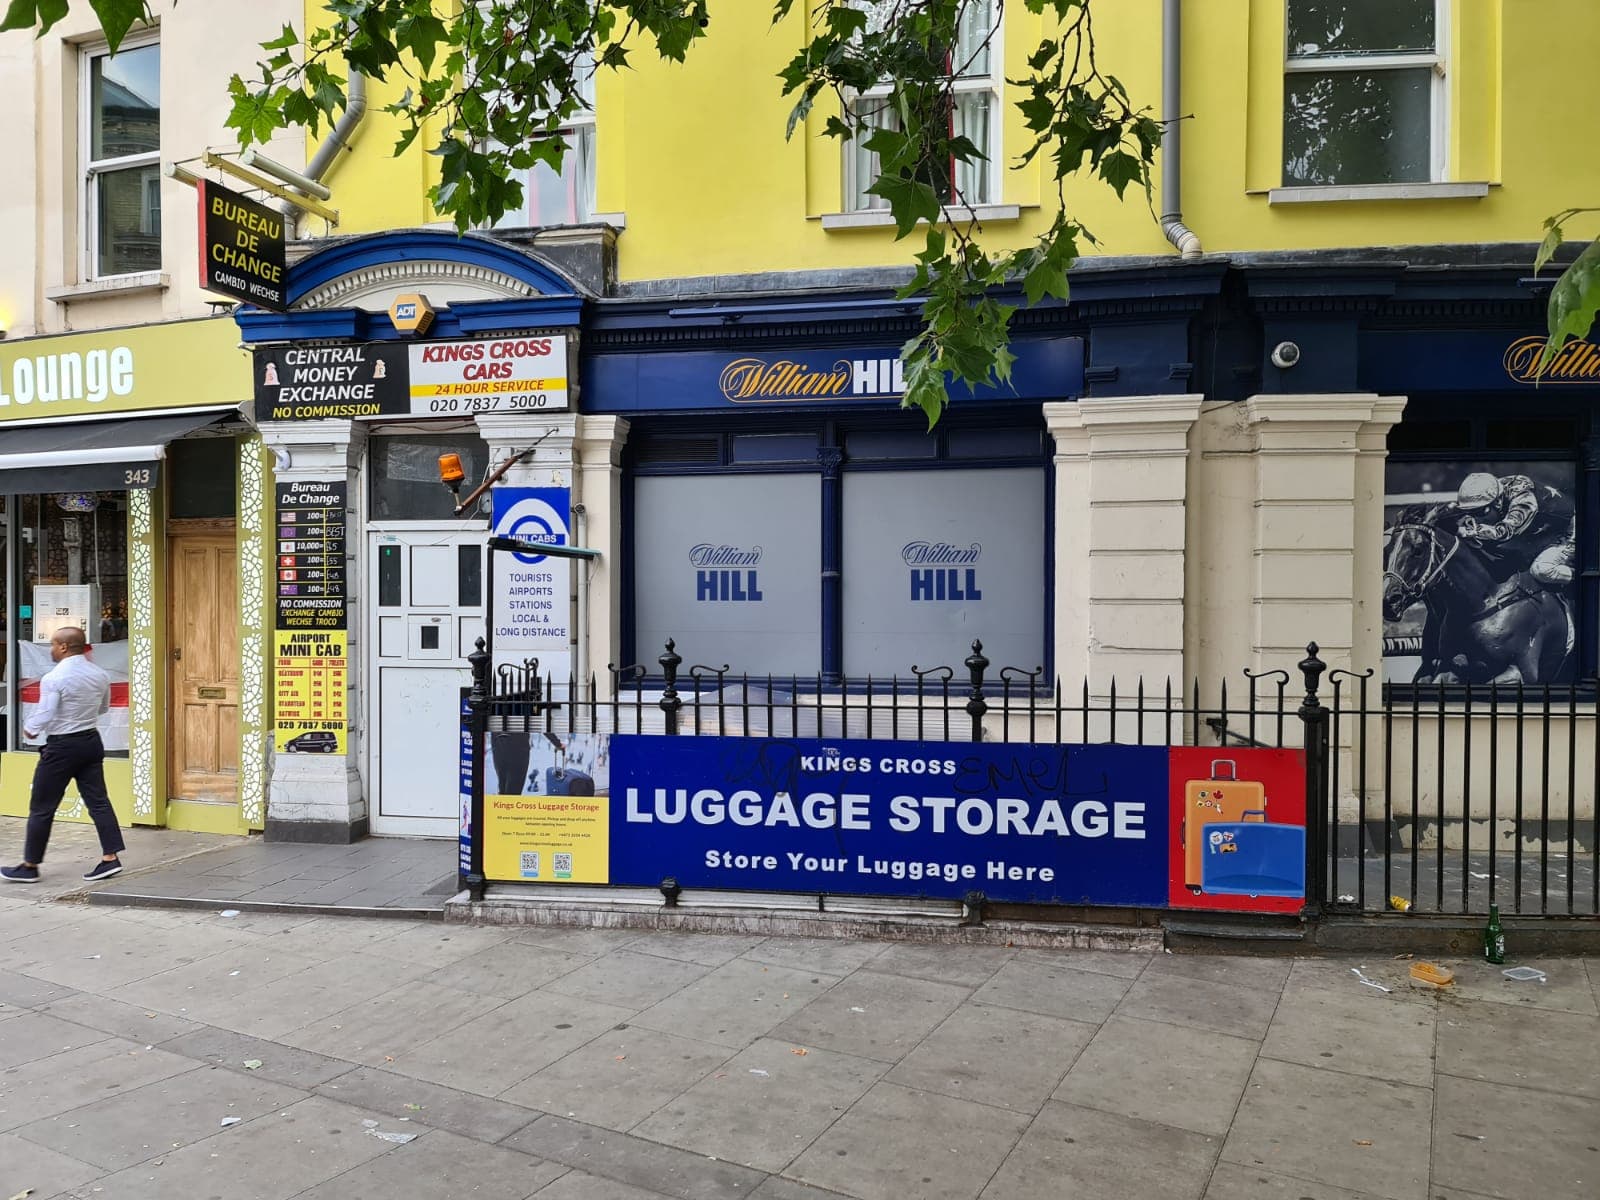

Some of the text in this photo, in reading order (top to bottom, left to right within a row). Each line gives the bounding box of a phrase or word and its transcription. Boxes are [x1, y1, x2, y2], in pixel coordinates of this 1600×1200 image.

[211, 197, 280, 240] BUREAU
[236, 230, 259, 253] DE
[211, 245, 282, 284] CHANGE
[215, 271, 280, 303] CAMBIO WECHSE
[397, 305, 415, 318] ADT
[284, 348, 366, 366] CENTRAL
[422, 338, 552, 363] KINGS CROSS
[0, 347, 133, 406] Lounge
[293, 367, 358, 383] MONEY
[462, 362, 514, 380] CARS
[434, 380, 545, 394] 24 HOUR SERVICE
[719, 358, 908, 402] William HIL
[278, 384, 375, 403] EXCHANGE
[272, 403, 381, 418] NO COMMISSION
[430, 395, 547, 412] 020 7837 5000
[124, 469, 150, 484] 343
[291, 483, 330, 493] Bureau
[282, 493, 340, 506] De Change
[306, 512, 324, 520] 100=
[306, 527, 324, 535] 100=
[530, 534, 557, 543] CABS
[306, 555, 324, 563] 100=
[689, 543, 763, 569] William
[902, 541, 982, 566] William
[306, 570, 324, 578] 100=
[510, 573, 552, 583] TOURISTS
[306, 584, 324, 592] 100=
[509, 587, 553, 596] AIRPORTS
[697, 570, 763, 601] HILL
[910, 569, 982, 601] HILL
[280, 599, 342, 608] NO COMMISSION
[509, 601, 552, 610] STATIONS
[281, 608, 343, 617] EXCHANGE CAMBIO
[512, 614, 549, 623] LOCAL &
[286, 618, 312, 626] WECHSE
[291, 634, 331, 643] AIRPORT
[495, 627, 566, 637] LONG DISTANCE
[280, 645, 341, 656] MINI CAB
[278, 721, 343, 730] 020 7837 5000
[801, 756, 957, 775] KINGS CROSS
[493, 801, 599, 812] Kings Cross Luggage Storage
[626, 787, 1146, 839] LUGGAGE STORAGE
[705, 849, 1055, 882] Store Your Luggage Here
